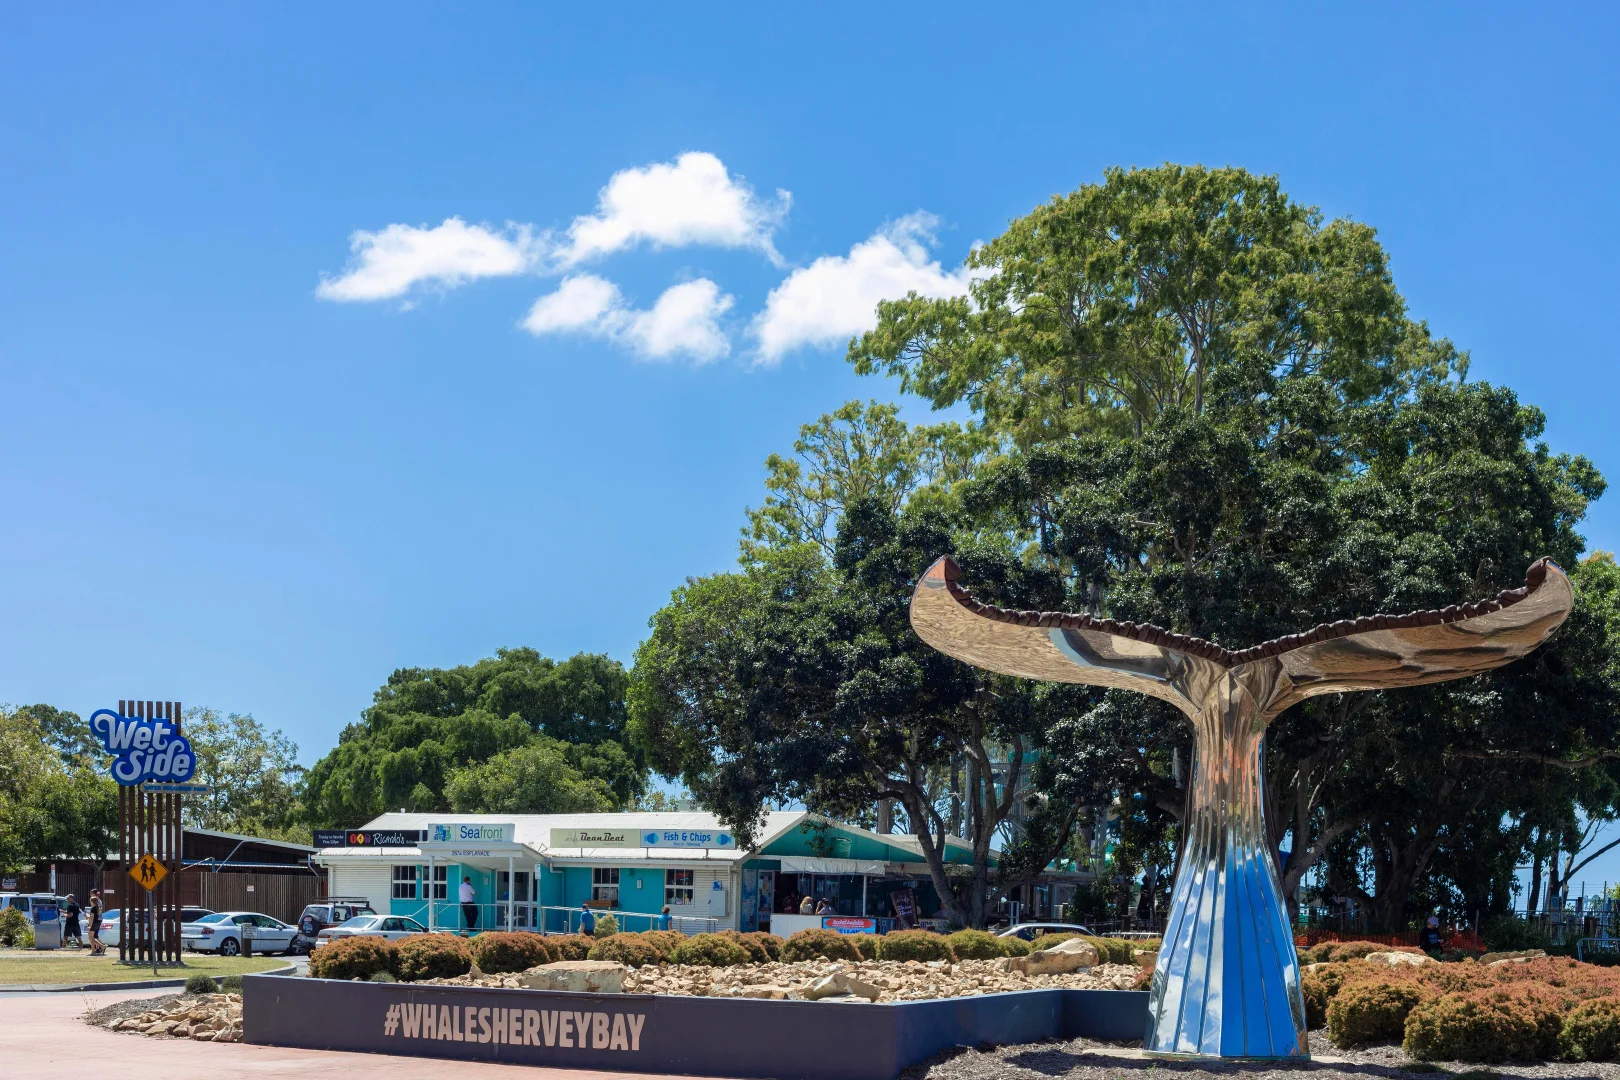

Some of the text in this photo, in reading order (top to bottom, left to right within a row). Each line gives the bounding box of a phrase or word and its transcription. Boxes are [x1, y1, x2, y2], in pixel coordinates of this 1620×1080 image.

[94, 713, 171, 751] Wet
[115, 740, 190, 781] Side
[372, 832, 405, 846] Ricardo's
[460, 825, 503, 839] Seafront
[580, 832, 625, 842] Bean Beat
[663, 832, 711, 844] Fish & Chips
[384, 1002, 646, 1051] #WHALESHERVEYBAY
